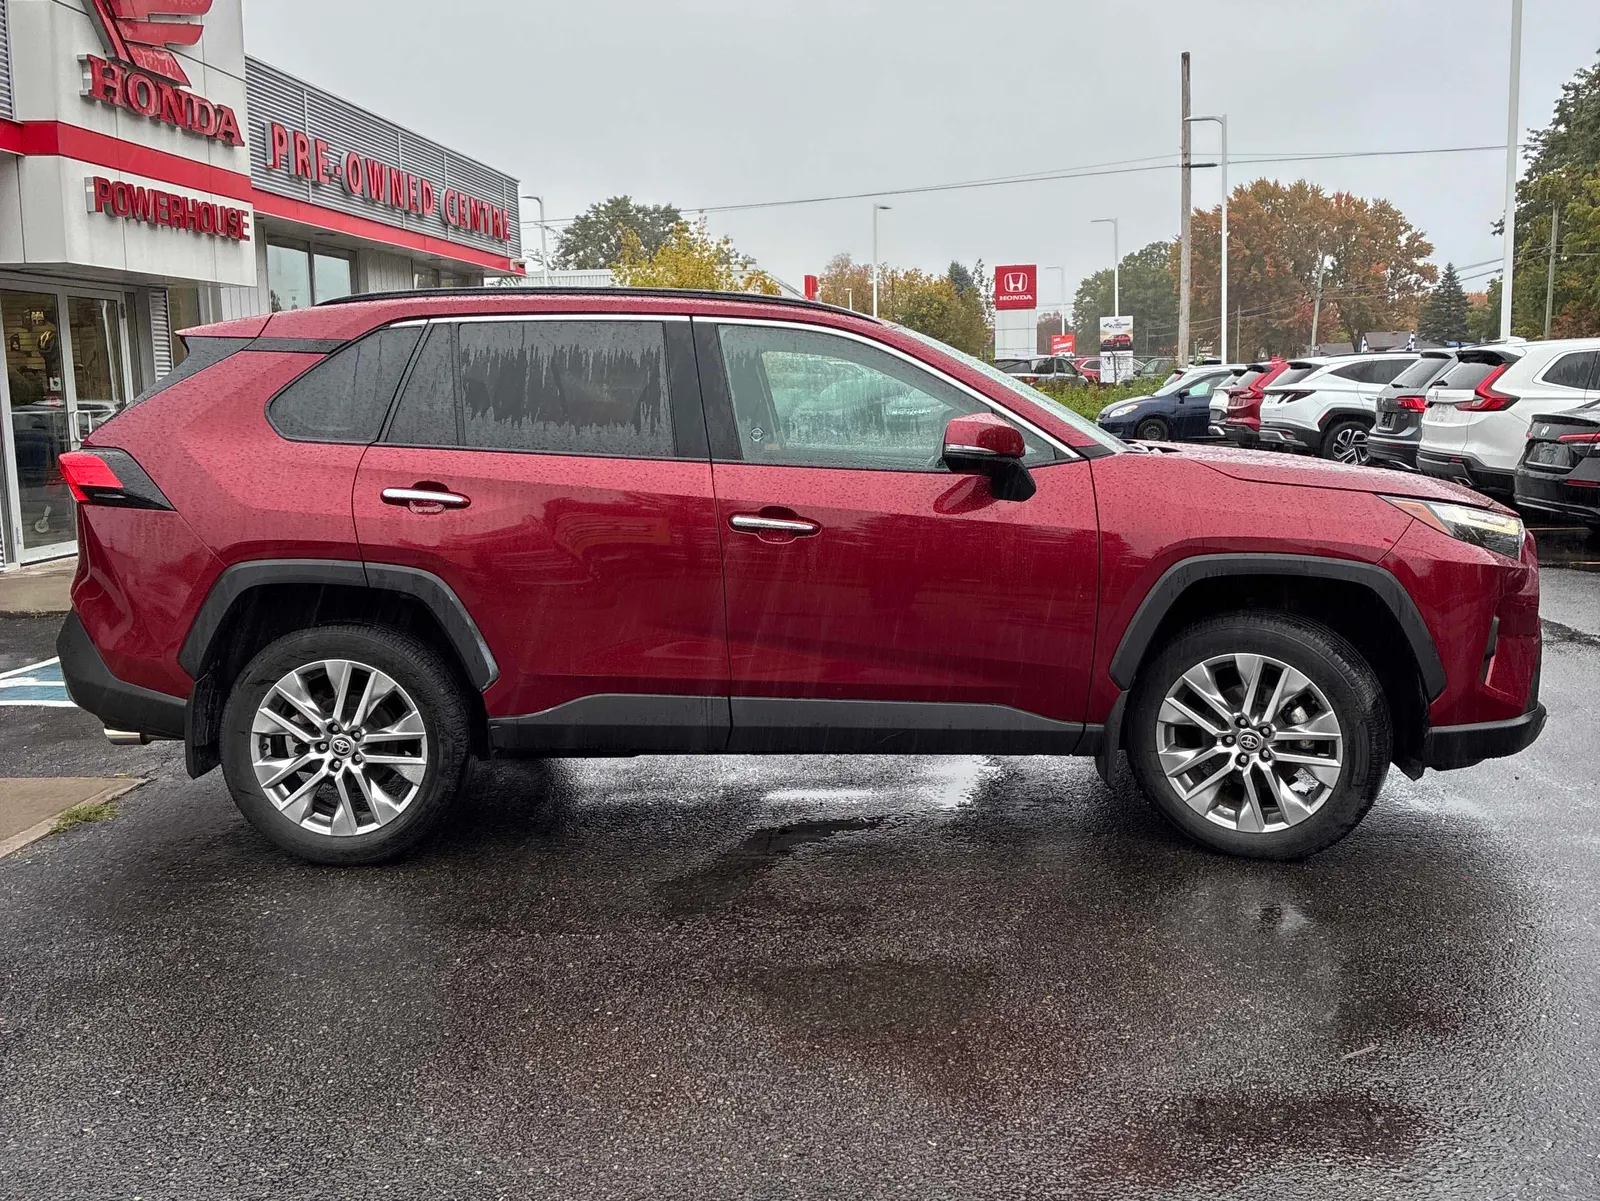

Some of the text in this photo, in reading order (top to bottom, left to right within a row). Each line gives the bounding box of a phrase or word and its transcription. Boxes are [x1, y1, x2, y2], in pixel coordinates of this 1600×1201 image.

[81, 54, 246, 147] HONDA
[86, 176, 250, 241] POWERHOUSE
[265, 121, 511, 241] PRE-OWNED CENTRE
